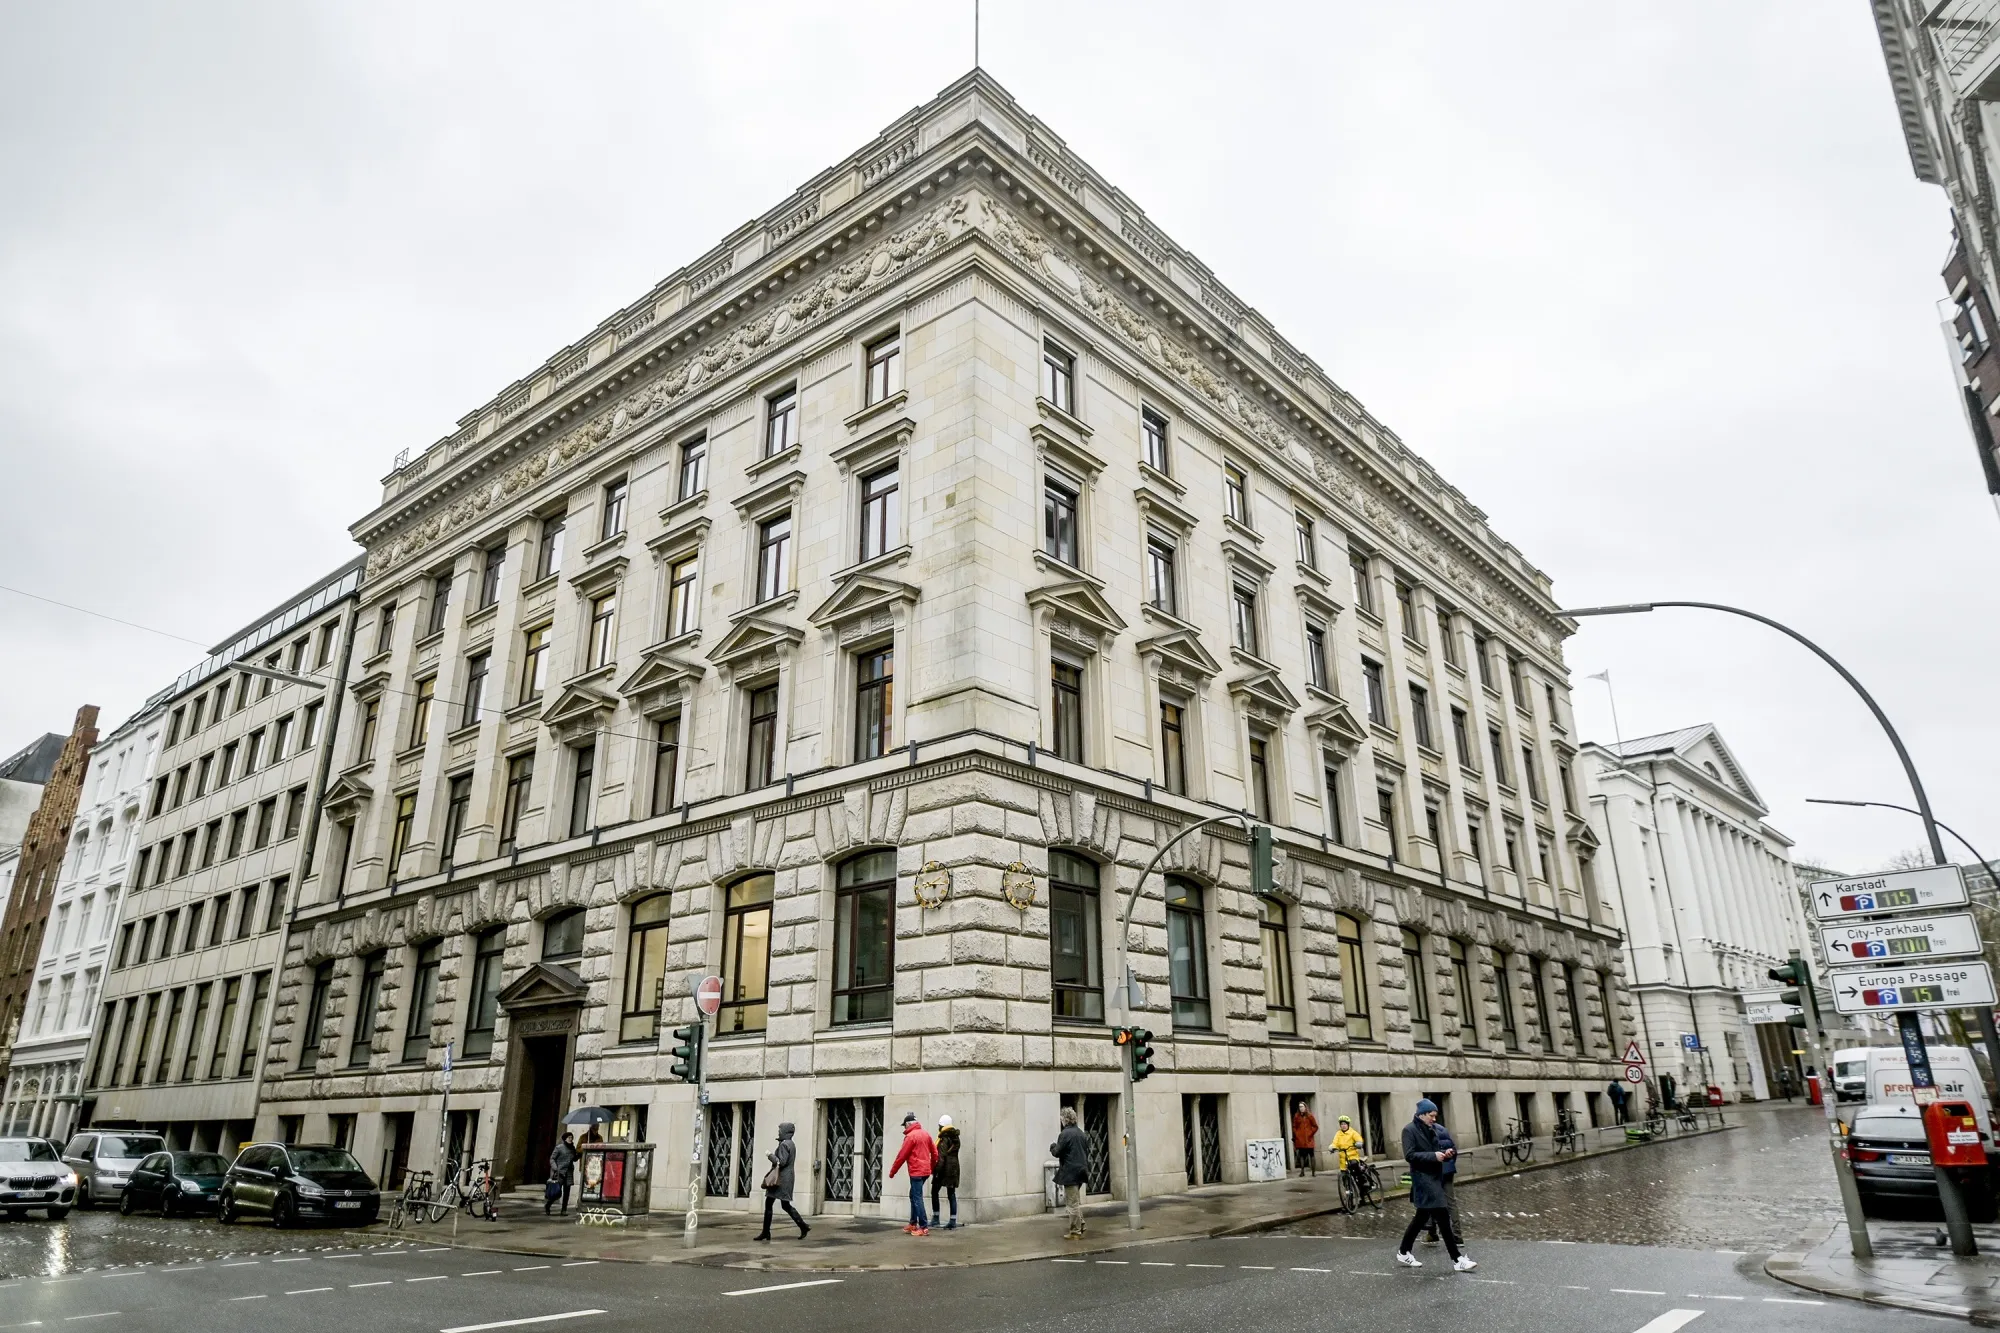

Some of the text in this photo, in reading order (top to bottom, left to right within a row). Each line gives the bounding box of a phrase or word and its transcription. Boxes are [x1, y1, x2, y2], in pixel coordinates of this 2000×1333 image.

[1835, 879, 1887, 893] Karstadt
[1881, 891, 1912, 906] 115
[1919, 890, 1934, 898] frei
[1847, 922, 1934, 940] City-Parkhaus
[1932, 938, 1947, 946] frei
[1858, 971, 1968, 987] Europa Passage
[1911, 987, 1933, 1002] 15
[1946, 988, 1960, 996] frei
[1629, 1069, 1640, 1079] 30
[1945, 1081, 1964, 1092] air
[577, 1092, 587, 1103] 75
